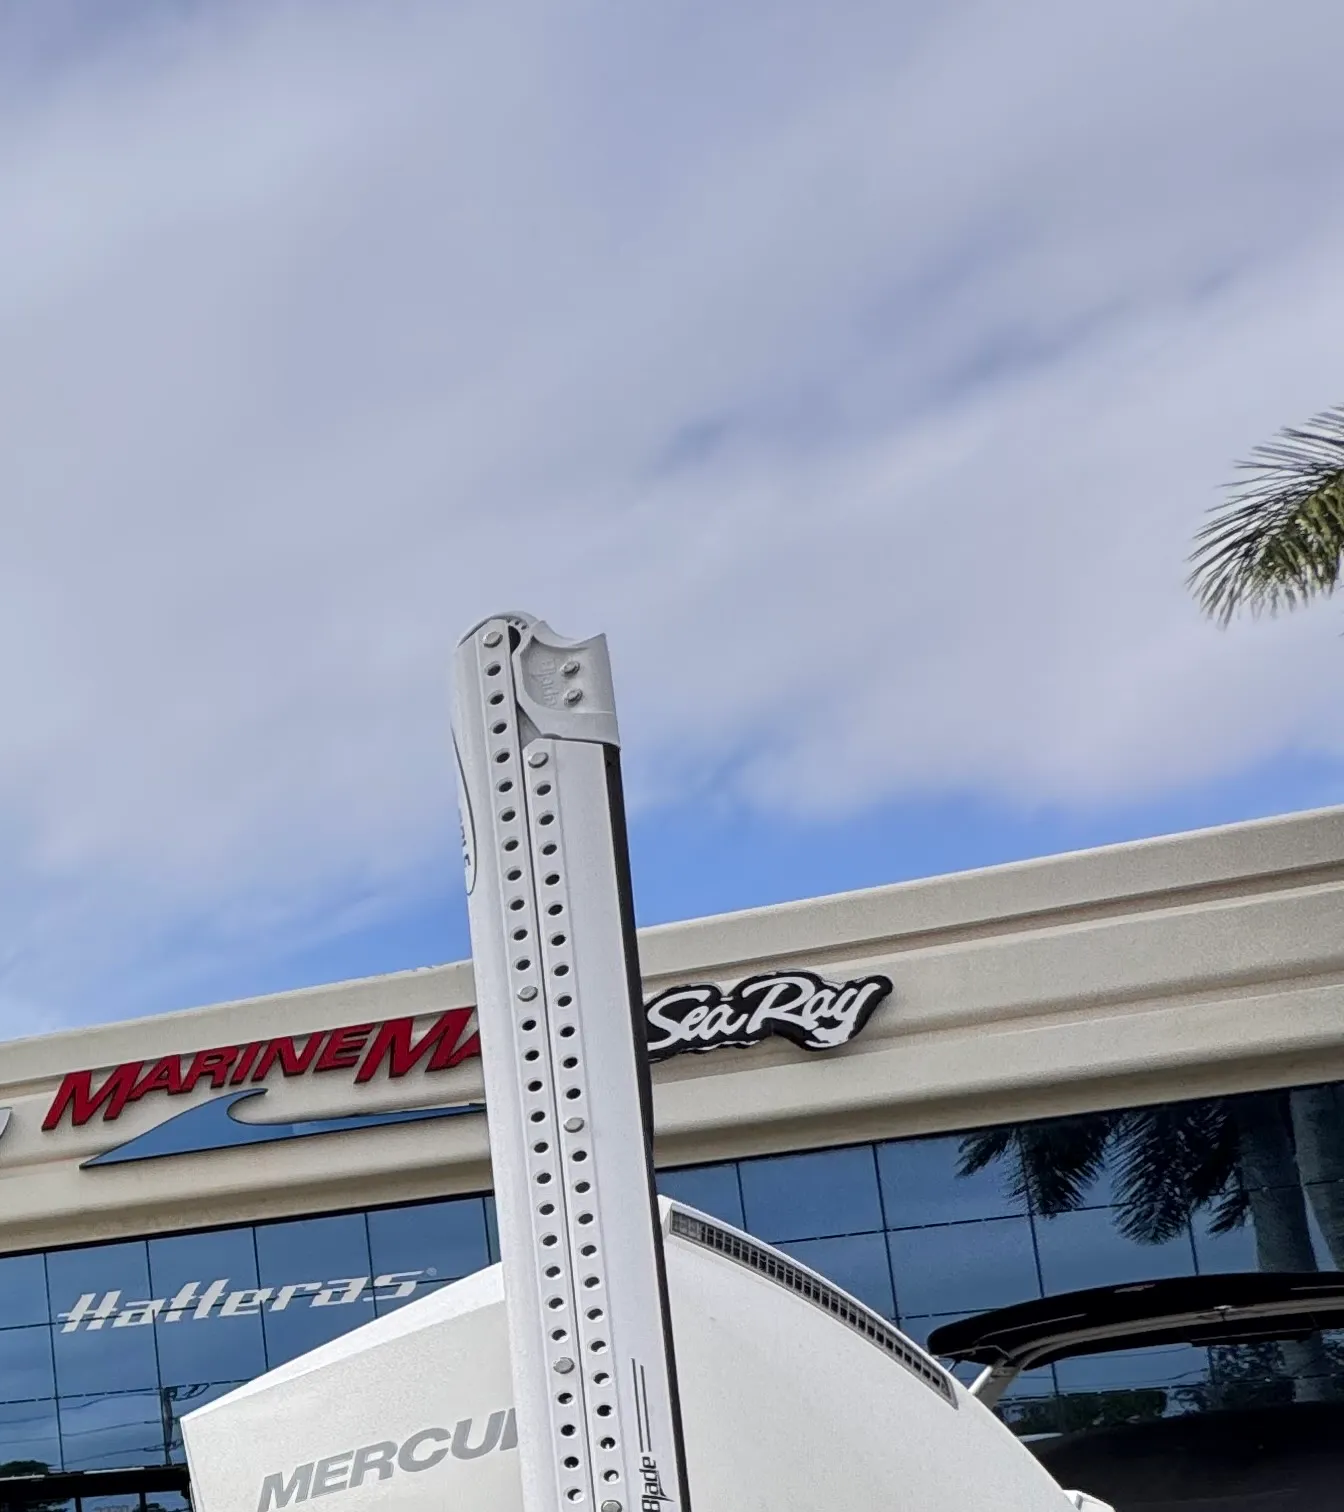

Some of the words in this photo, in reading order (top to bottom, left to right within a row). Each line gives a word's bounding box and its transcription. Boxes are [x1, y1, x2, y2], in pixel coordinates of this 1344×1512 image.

[647, 989, 749, 1051] Sea
[742, 976, 882, 1048] Ray
[41, 1006, 481, 1132] MARINEM
[57, 1270, 424, 1334] Hatteras
